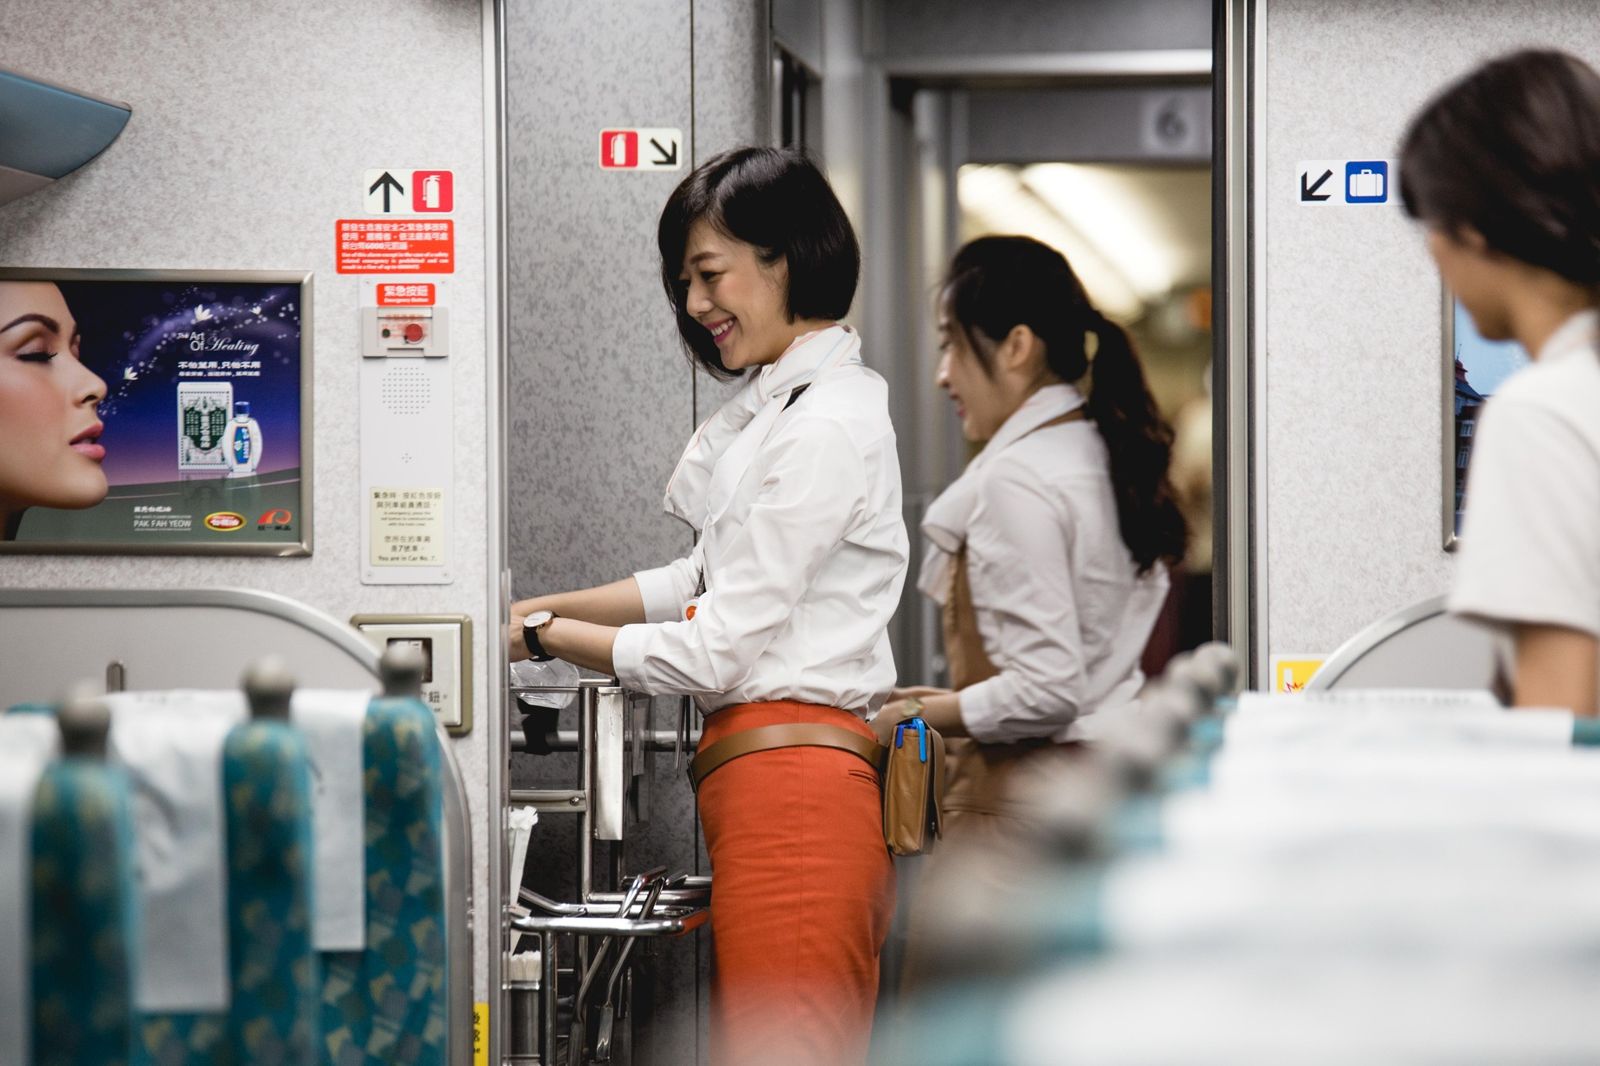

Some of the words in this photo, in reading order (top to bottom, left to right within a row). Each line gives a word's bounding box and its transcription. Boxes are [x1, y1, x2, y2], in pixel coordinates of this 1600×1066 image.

[1155, 94, 1188, 146] 6
[190, 332, 204, 340] Art
[190, 340, 205, 352] Of
[205, 336, 260, 356] Healing
[134, 519, 150, 527] PAK
[151, 519, 168, 527] FAH
[169, 519, 192, 527] YEOW
